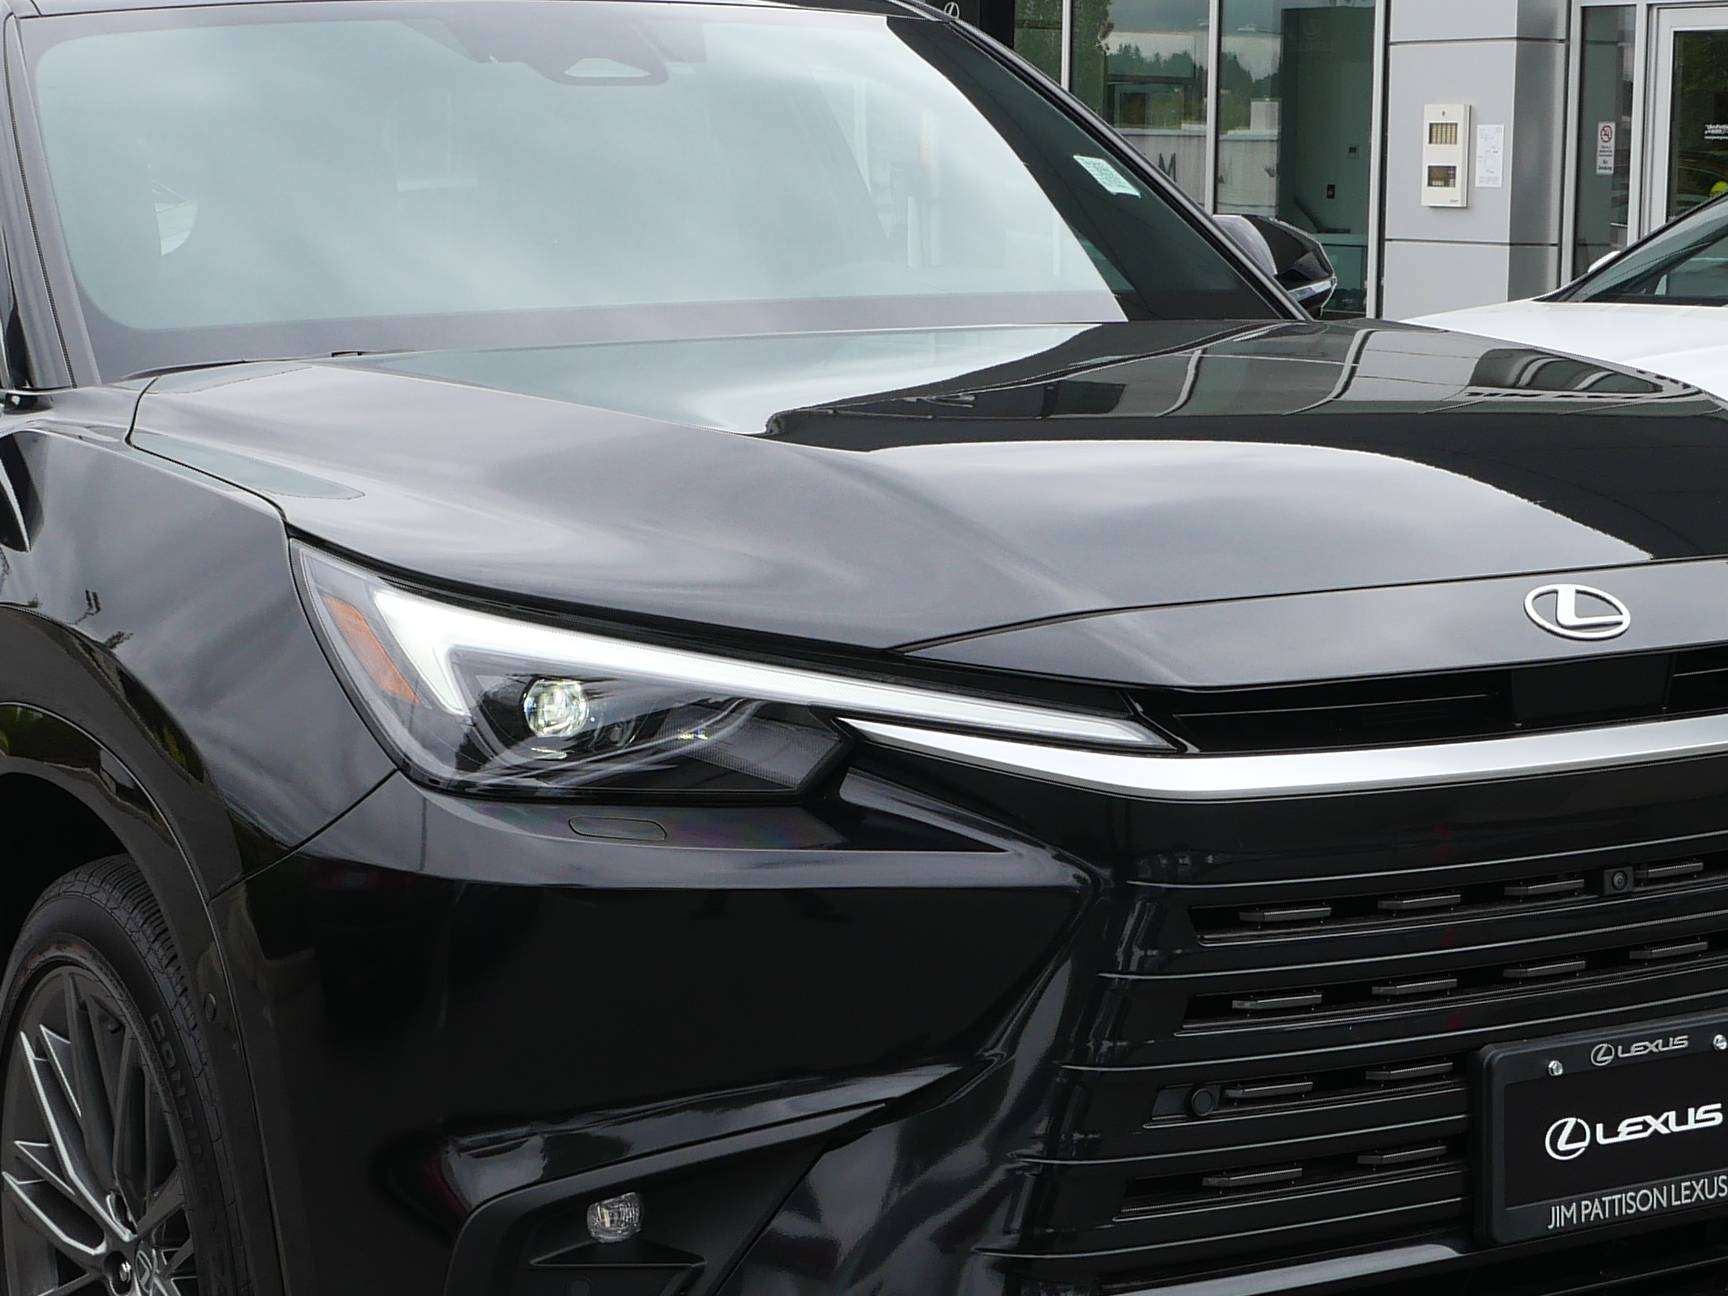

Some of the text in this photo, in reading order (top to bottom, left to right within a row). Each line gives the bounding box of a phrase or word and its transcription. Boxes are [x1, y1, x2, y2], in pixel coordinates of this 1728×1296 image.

[1618, 1035, 1688, 1058] LEXUS
[1596, 1103, 1723, 1144] LEXUS
[1548, 1175, 1728, 1230] JIM PATTISON LEXUS
